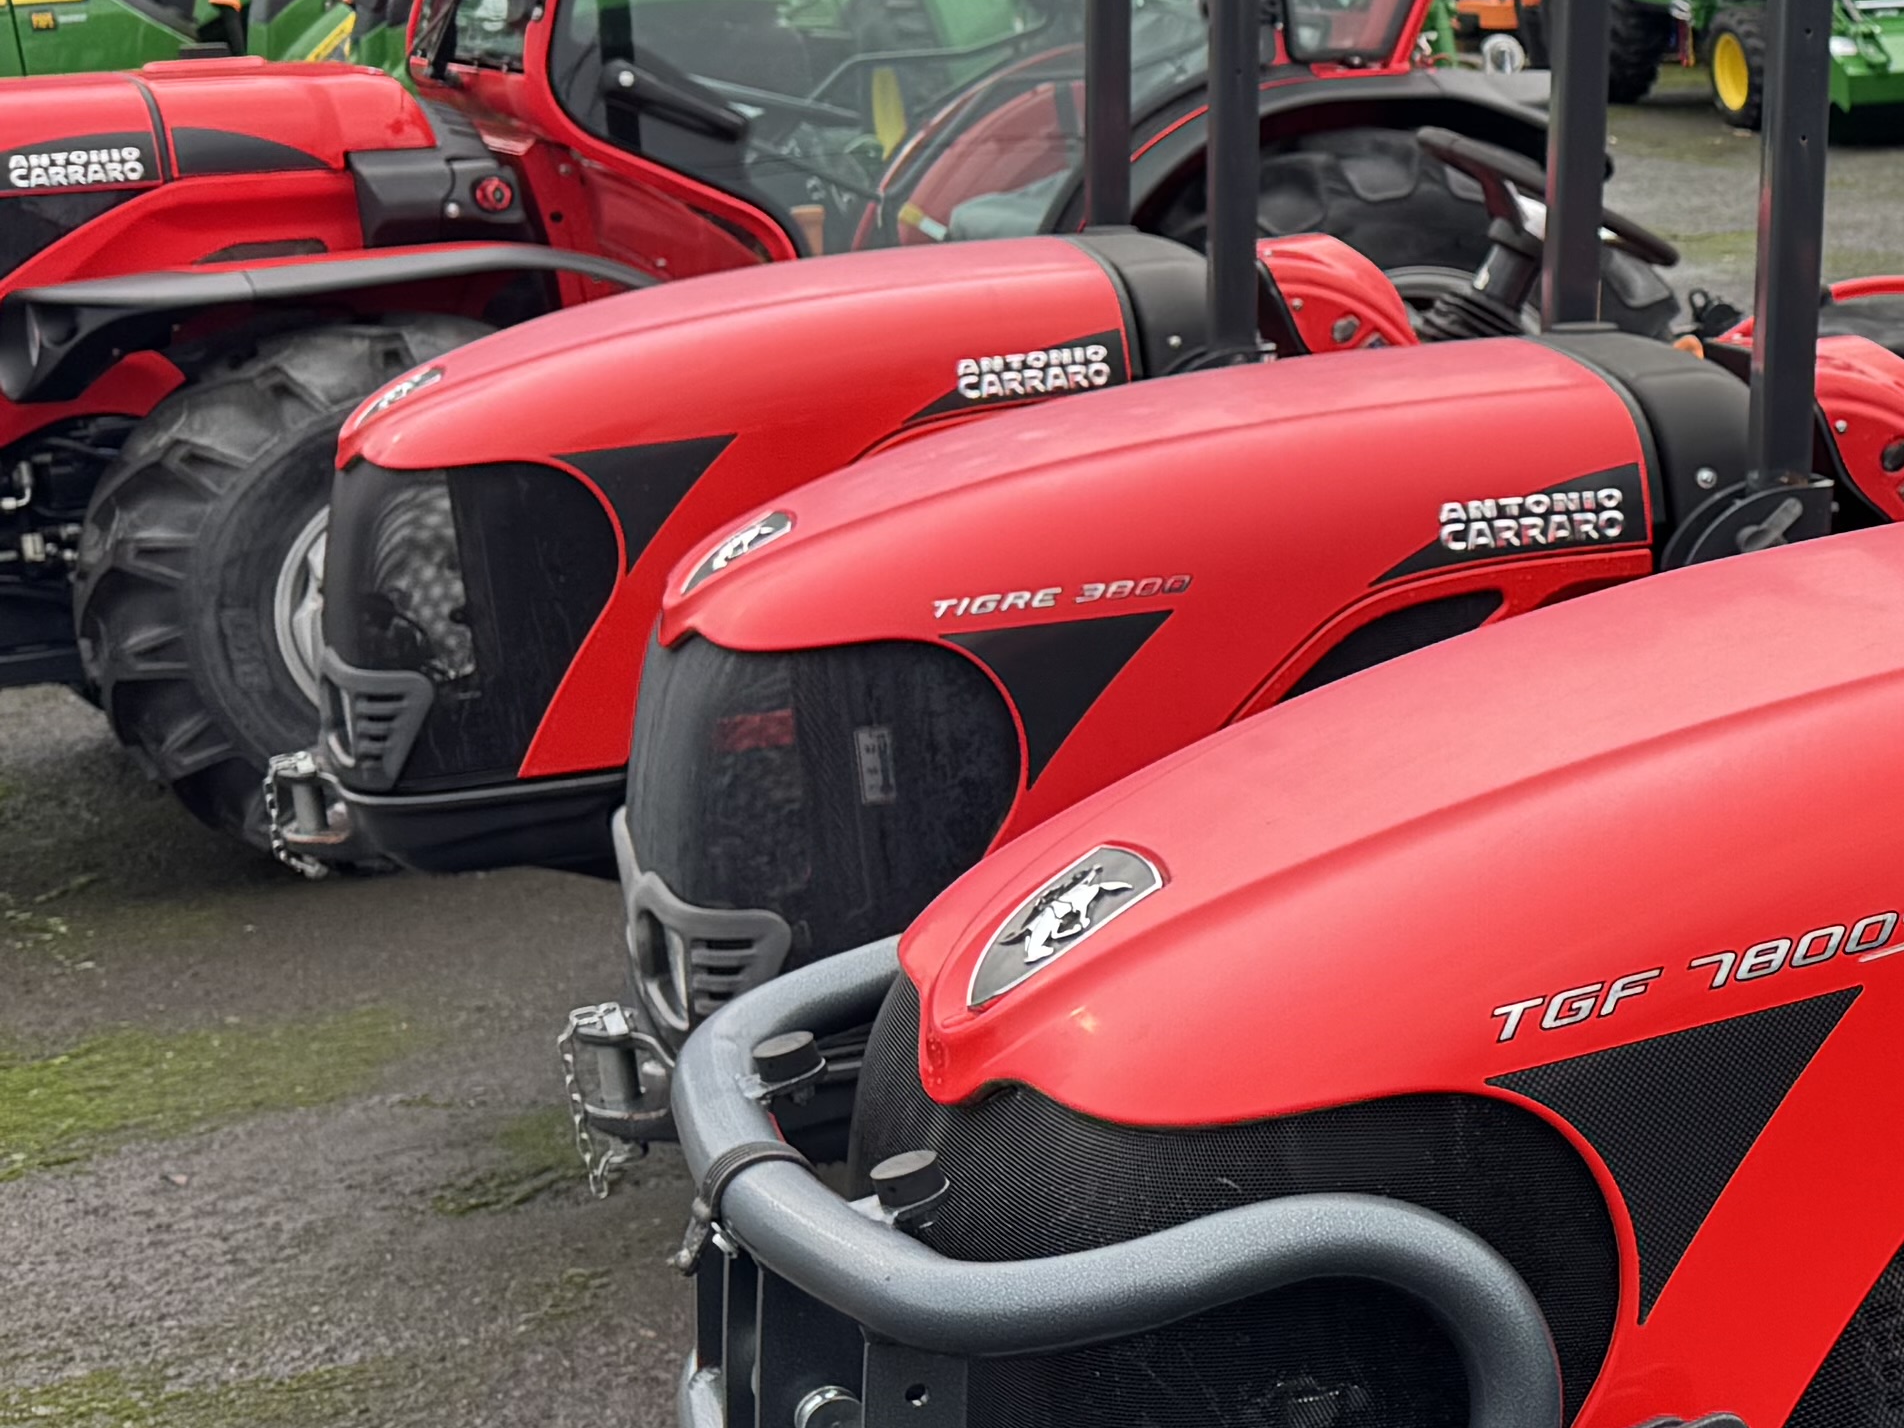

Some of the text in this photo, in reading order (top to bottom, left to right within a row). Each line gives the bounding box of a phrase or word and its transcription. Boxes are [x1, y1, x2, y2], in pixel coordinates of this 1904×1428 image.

[8, 146, 141, 170] ANTONIO
[9, 161, 145, 188] CARRARO
[956, 344, 1108, 377] ANTONIO
[957, 362, 1111, 400] CARRARO
[1439, 487, 1623, 523] ANTONIO
[1440, 509, 1625, 551] CARRARO
[932, 574, 1192, 620] TIGRE 3800
[1491, 967, 1664, 1043] TGF
